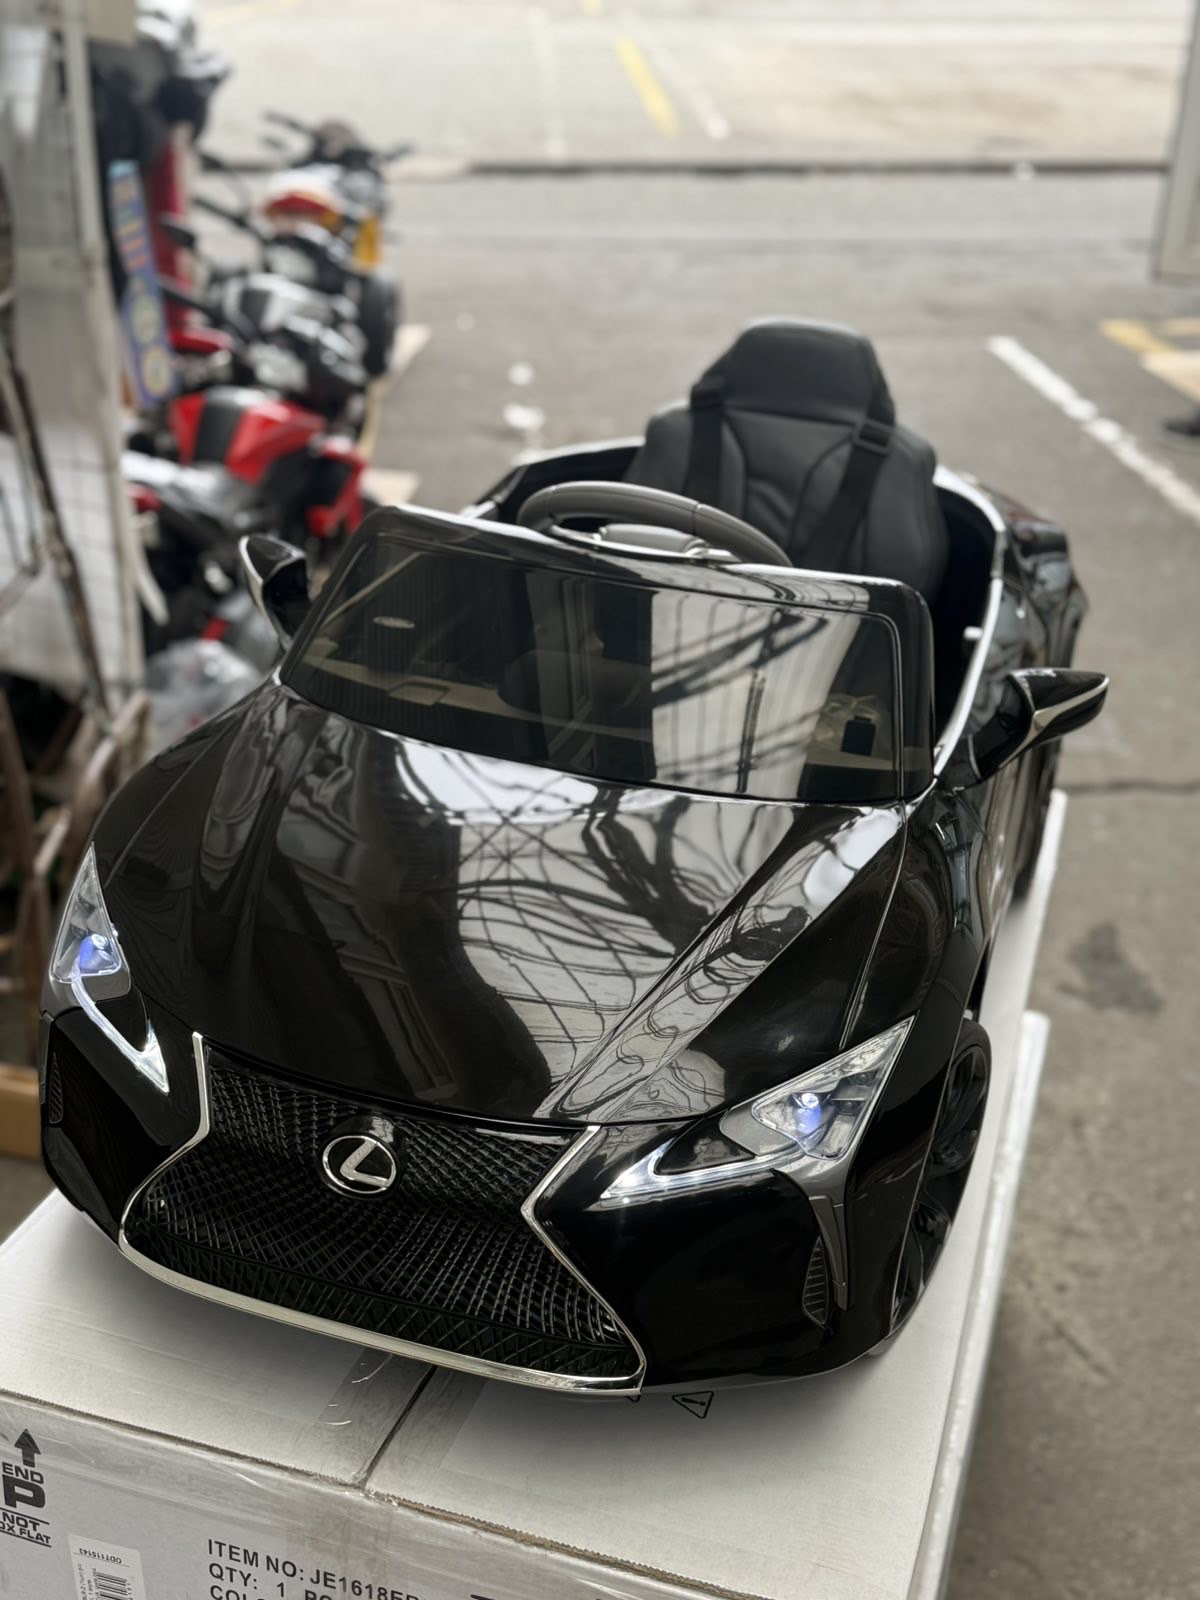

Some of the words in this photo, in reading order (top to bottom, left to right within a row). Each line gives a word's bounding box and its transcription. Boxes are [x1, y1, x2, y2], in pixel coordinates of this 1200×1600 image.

[2, 1461, 44, 1485] END
[2, 1511, 40, 1532] NOT
[19, 1528, 52, 1544] FLAT
[208, 1539, 259, 1567] ITEM
[266, 1555, 304, 1581] NO:
[209, 1563, 257, 1590] QTY:
[277, 1582, 285, 1598] 1
